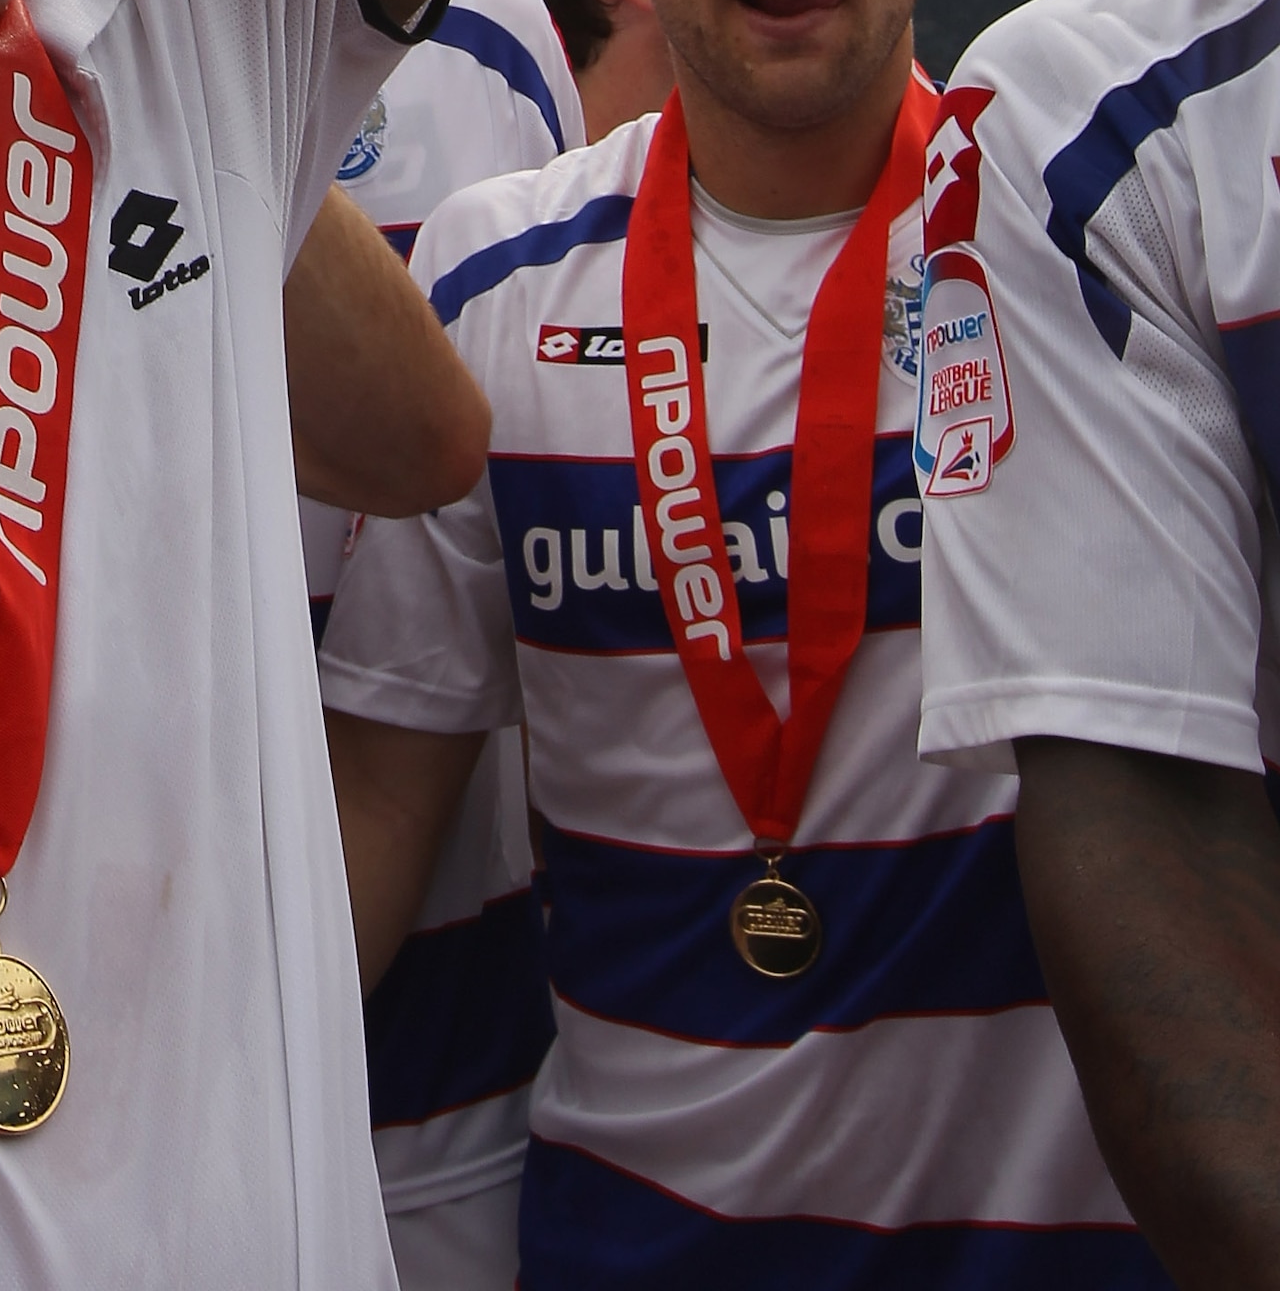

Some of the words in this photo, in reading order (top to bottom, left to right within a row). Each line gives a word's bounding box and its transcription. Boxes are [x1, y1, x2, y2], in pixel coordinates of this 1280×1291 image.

[128, 255, 211, 310] lotto
[928, 375, 993, 416] LEAGUE
[931, 357, 992, 392] FOOTBALL
[637, 334, 733, 661] npower
